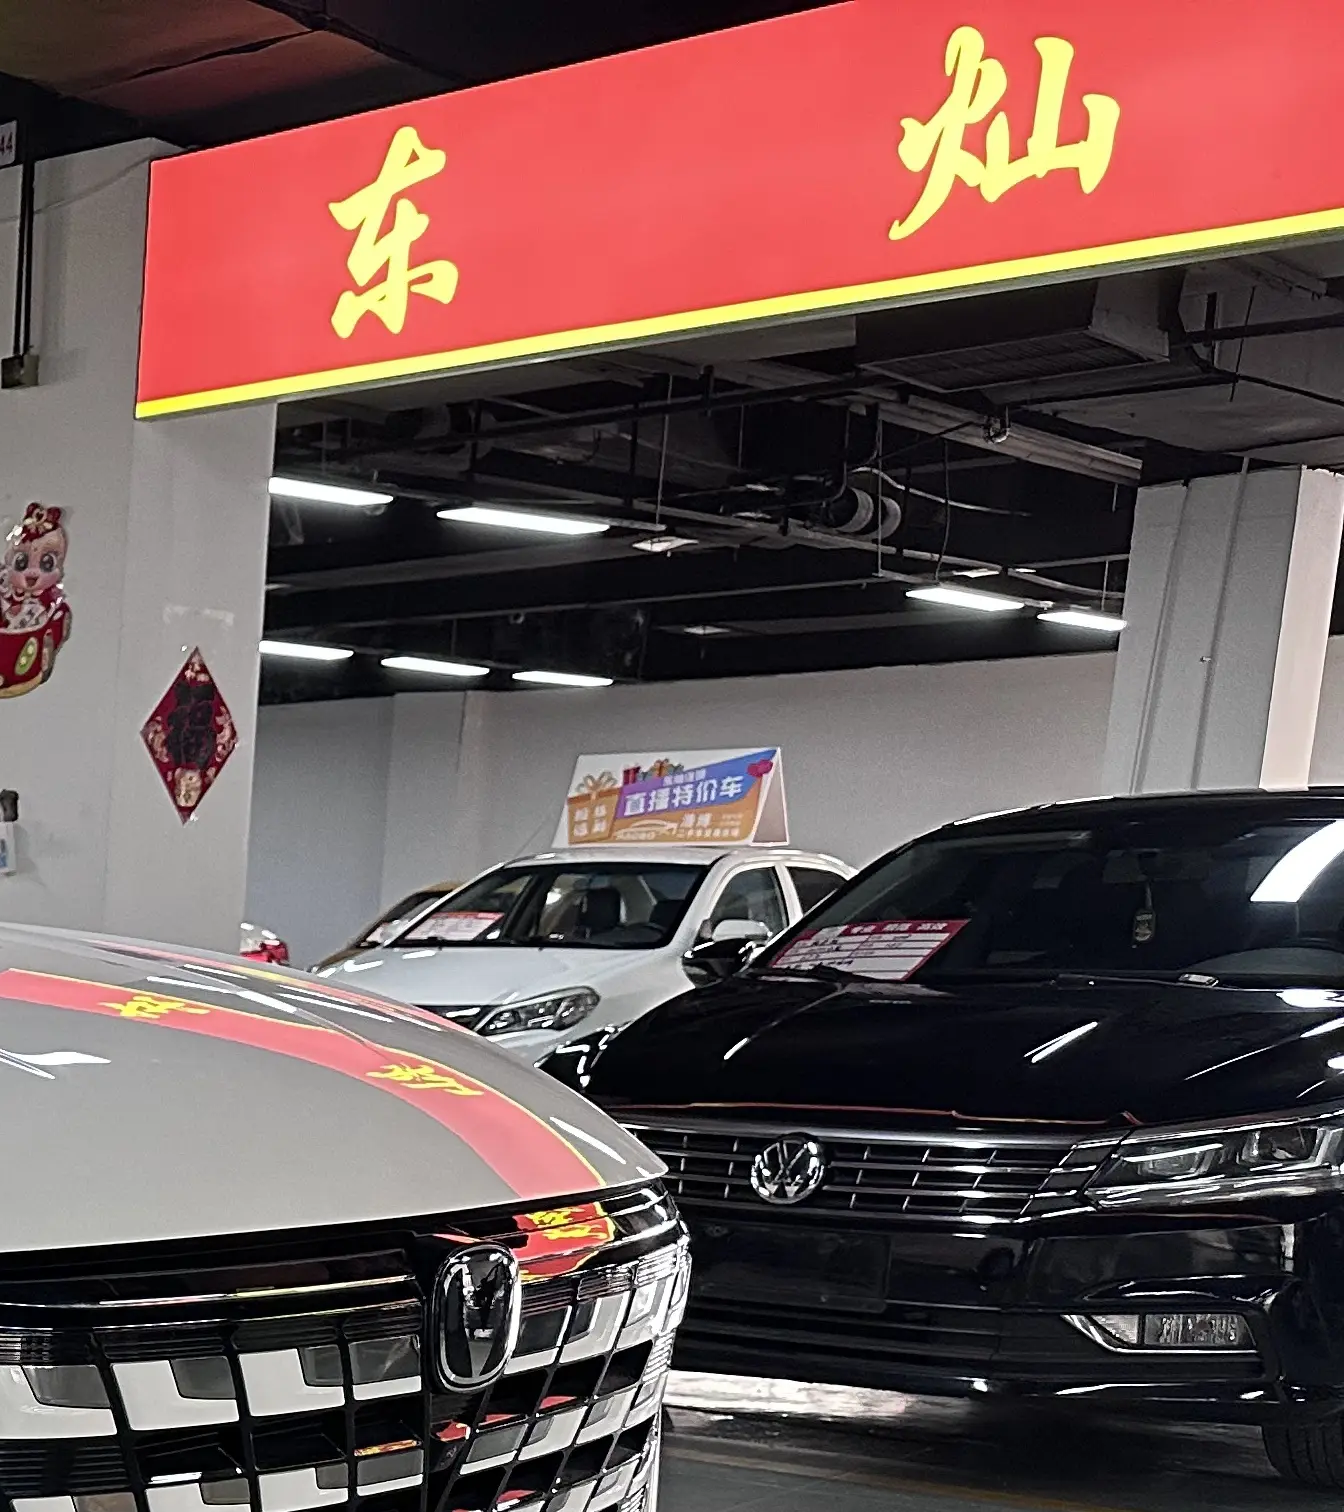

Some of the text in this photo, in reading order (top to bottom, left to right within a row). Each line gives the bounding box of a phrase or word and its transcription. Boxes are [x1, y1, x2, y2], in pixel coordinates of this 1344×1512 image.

[328, 24, 1122, 339] 东 灿
[623, 775, 744, 816] 直播特价车
